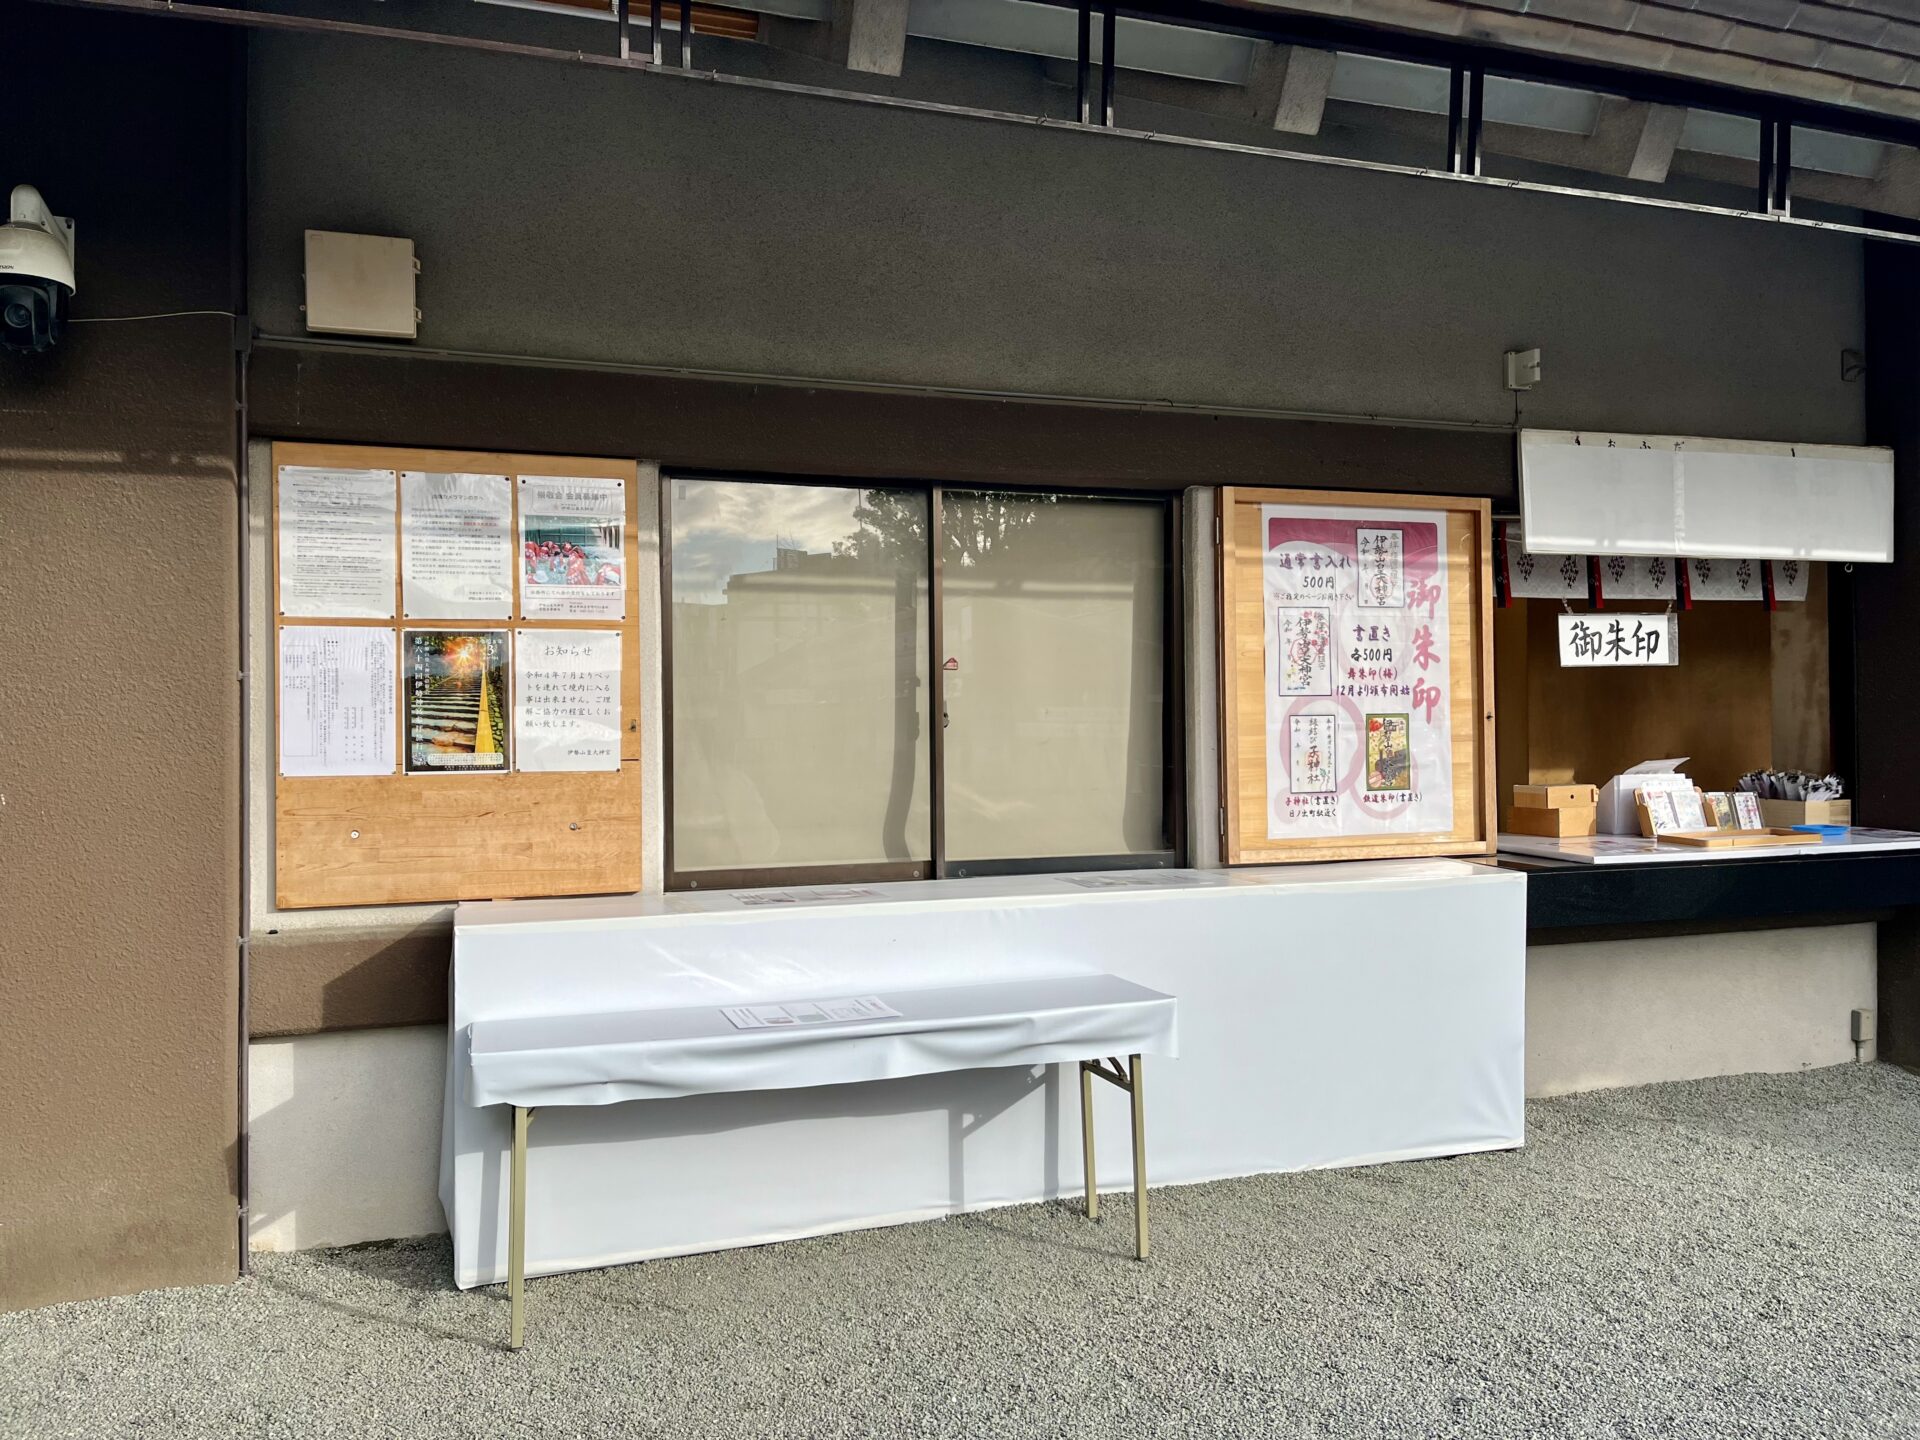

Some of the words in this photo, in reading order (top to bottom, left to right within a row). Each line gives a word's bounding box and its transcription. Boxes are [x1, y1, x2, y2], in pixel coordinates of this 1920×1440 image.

[1279, 552, 1351, 571] 通常書入れ
[1303, 576, 1334, 589] 500円
[1353, 624, 1390, 642] 書置き
[1569, 618, 1660, 662] 御朱印
[545, 645, 592, 657] お知らせ
[1351, 648, 1392, 662] 各500円
[1406, 577, 1441, 724] 御朱印
[527, 682, 610, 692] トを連れて境内に入る
[525, 695, 611, 704] 事は出来ません。ご理
[525, 720, 581, 728] 願い致します。
